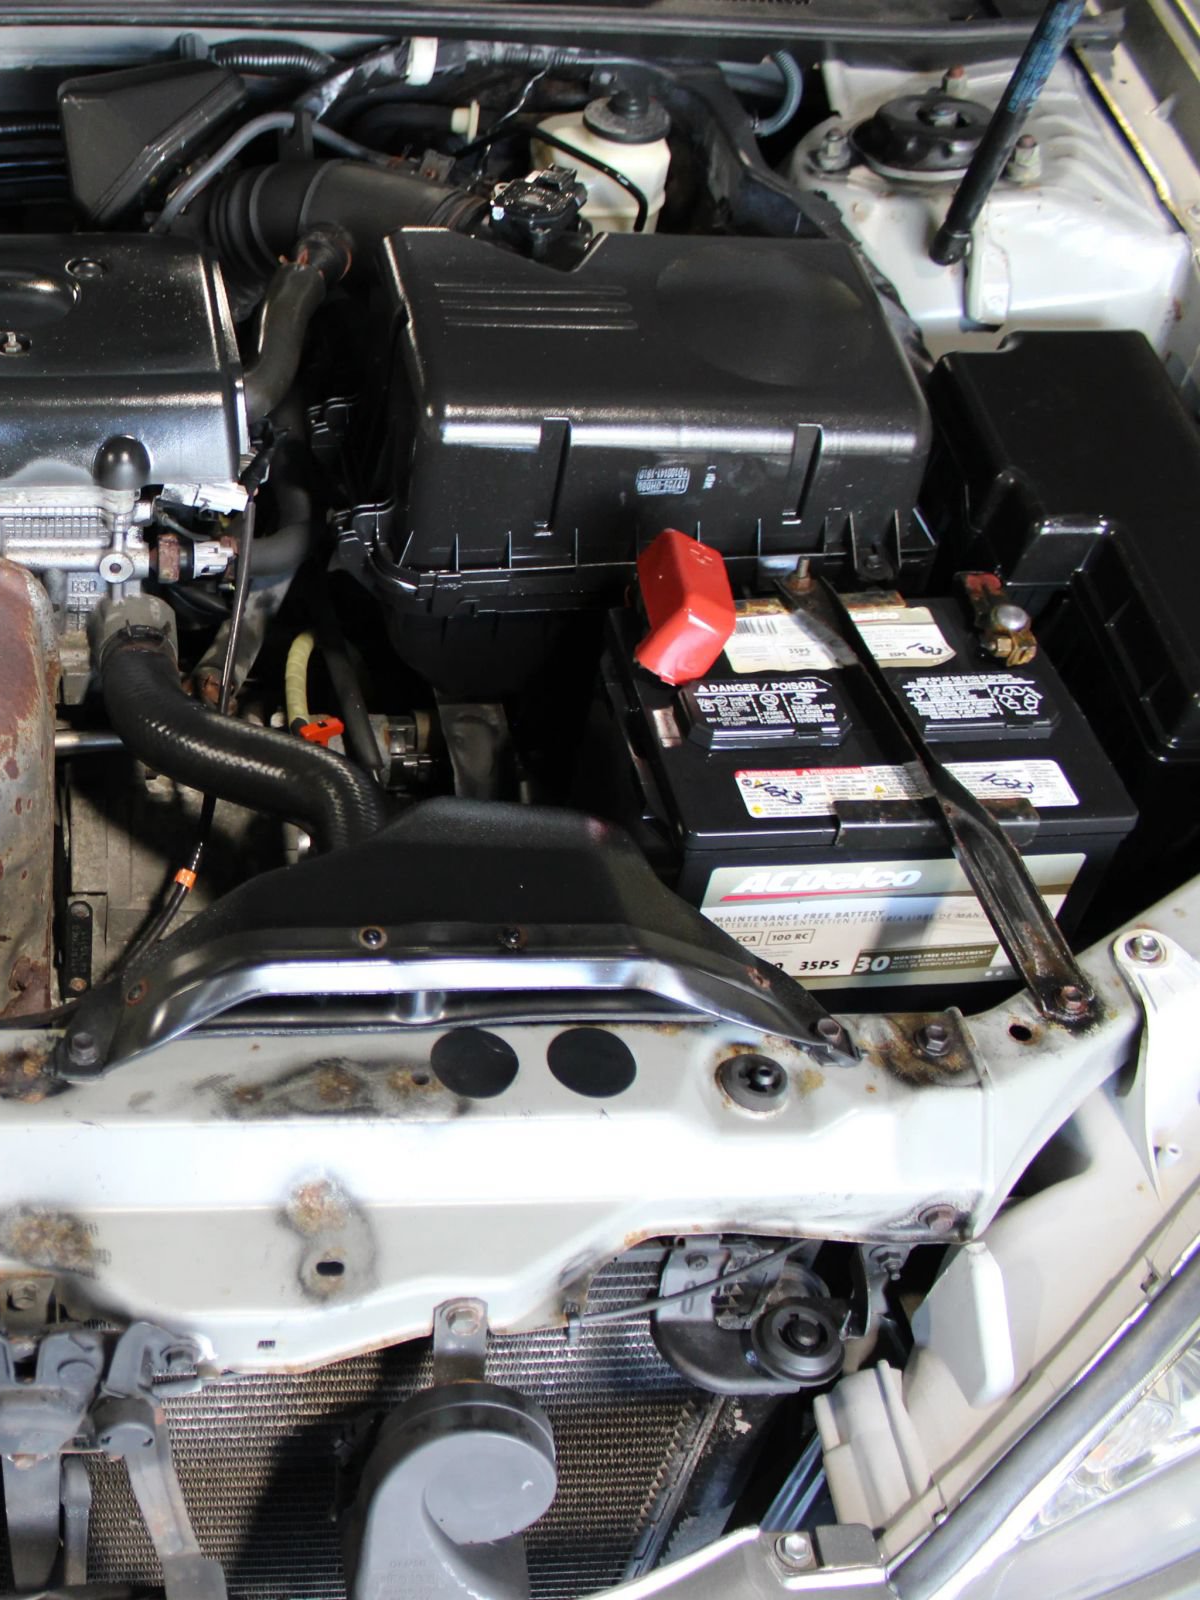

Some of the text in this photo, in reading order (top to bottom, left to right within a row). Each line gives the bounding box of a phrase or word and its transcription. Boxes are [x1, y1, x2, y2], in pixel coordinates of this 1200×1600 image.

[709, 684, 759, 693] DANGER
[771, 682, 817, 691] POISON
[730, 867, 922, 893] ACDelco
[713, 909, 885, 923] MAINTENANCE FREE BATTERY
[772, 934, 792, 942] 100
[799, 960, 840, 970] 35PS
[853, 955, 891, 973] 30
